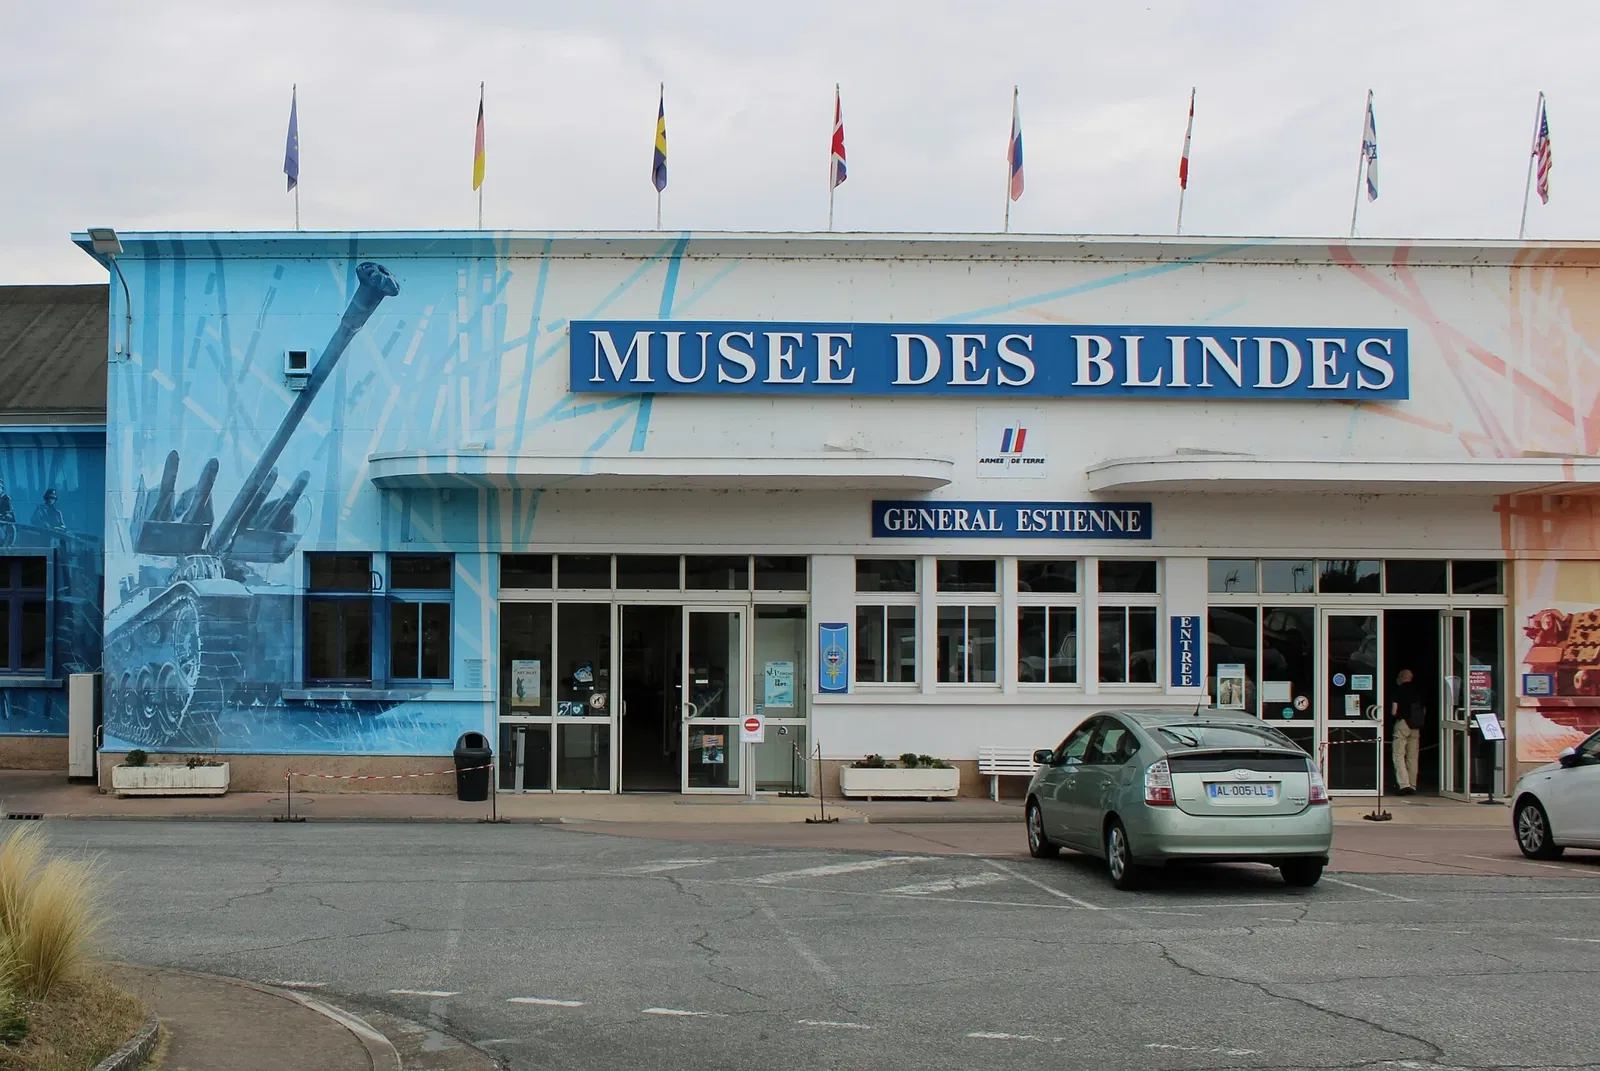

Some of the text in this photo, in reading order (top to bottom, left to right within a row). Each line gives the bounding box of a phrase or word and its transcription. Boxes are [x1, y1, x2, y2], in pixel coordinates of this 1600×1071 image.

[588, 330, 1395, 391] MUSEE DES BLINDES
[883, 508, 1141, 532] GENERAL ESTIENNE
[1180, 616, 1193, 686] ENTREE
[1217, 785, 1267, 796] AL-005-LL
